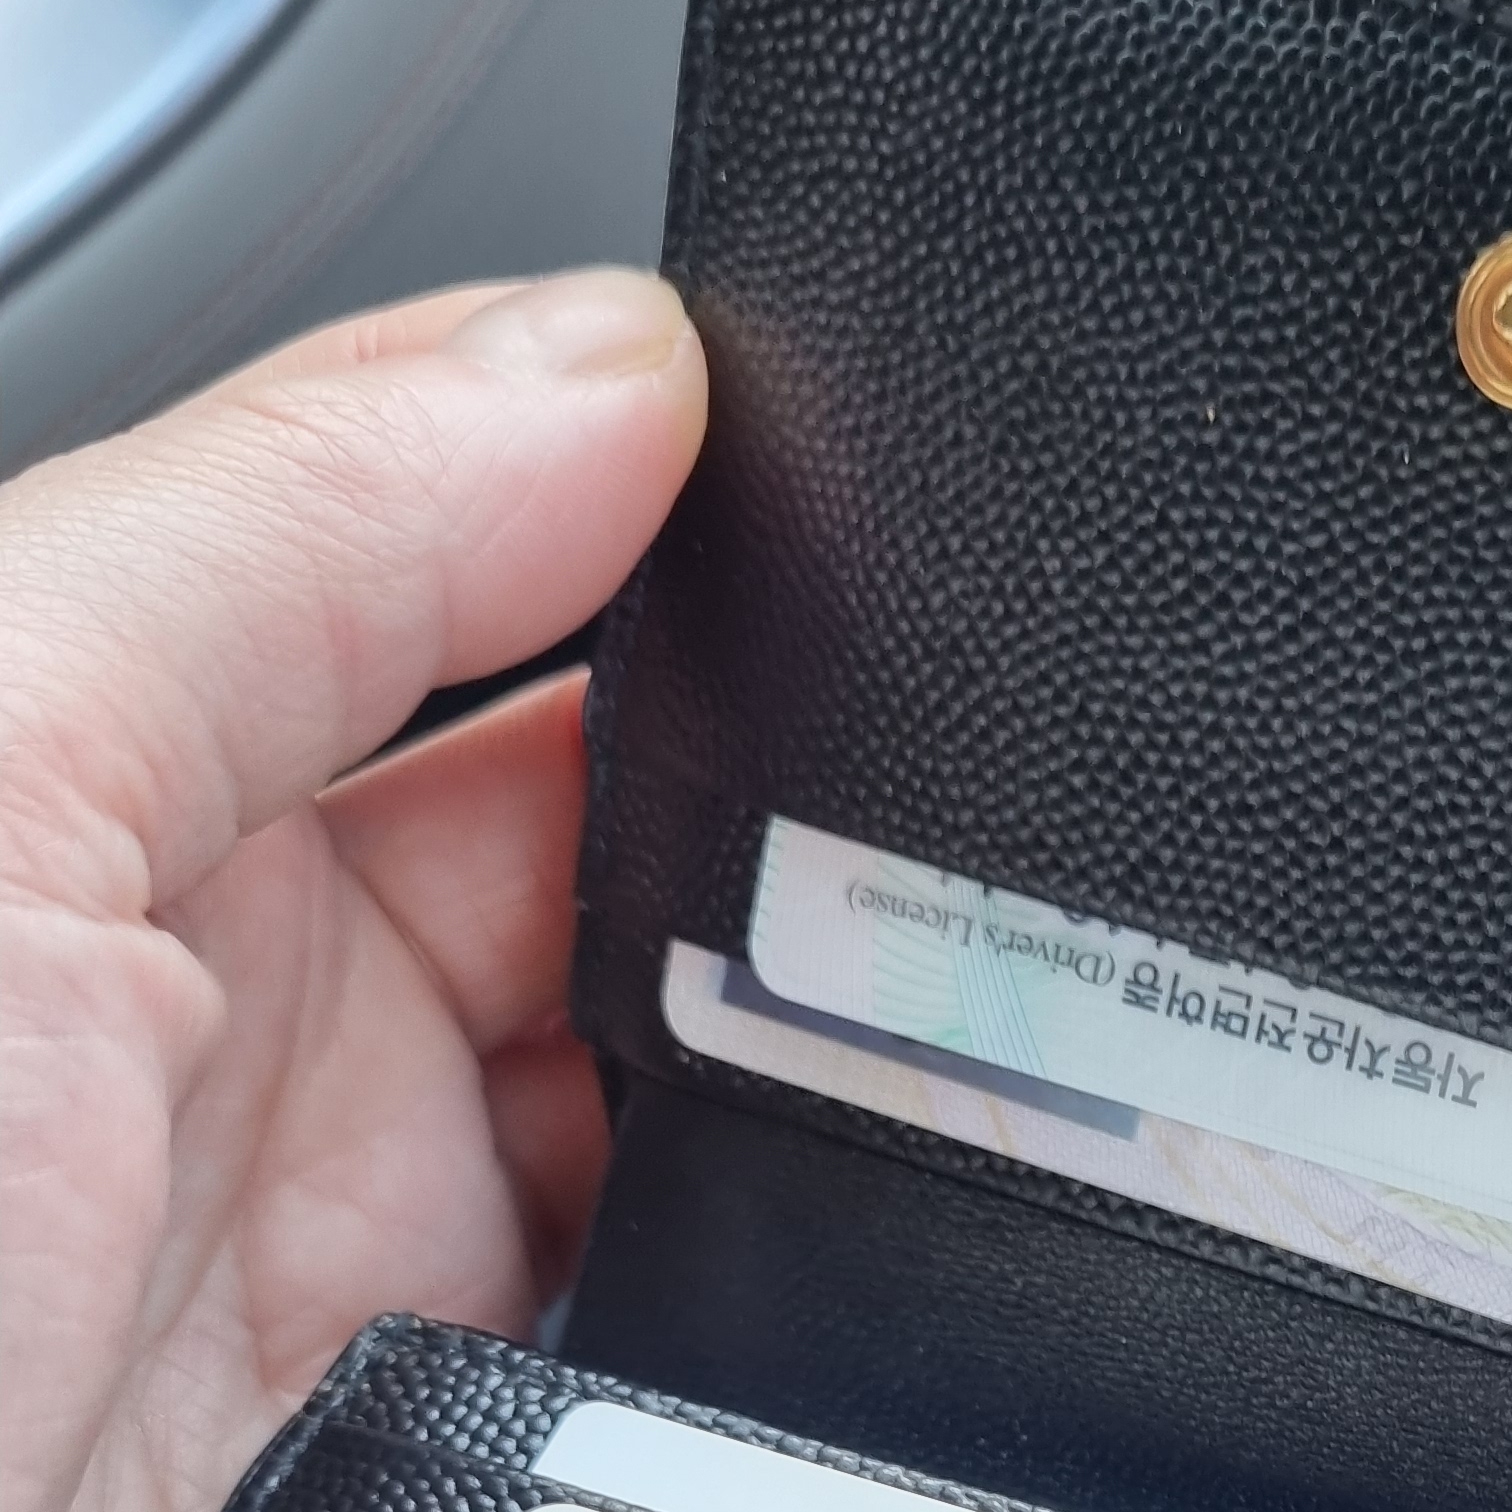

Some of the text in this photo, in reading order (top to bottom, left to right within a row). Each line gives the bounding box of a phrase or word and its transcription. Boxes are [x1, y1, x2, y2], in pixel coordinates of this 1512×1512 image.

[845, 880, 972, 949] License)
[984, 923, 1115, 989] (Driver's
[1124, 958, 1486, 1108] 자동차운전면허증
